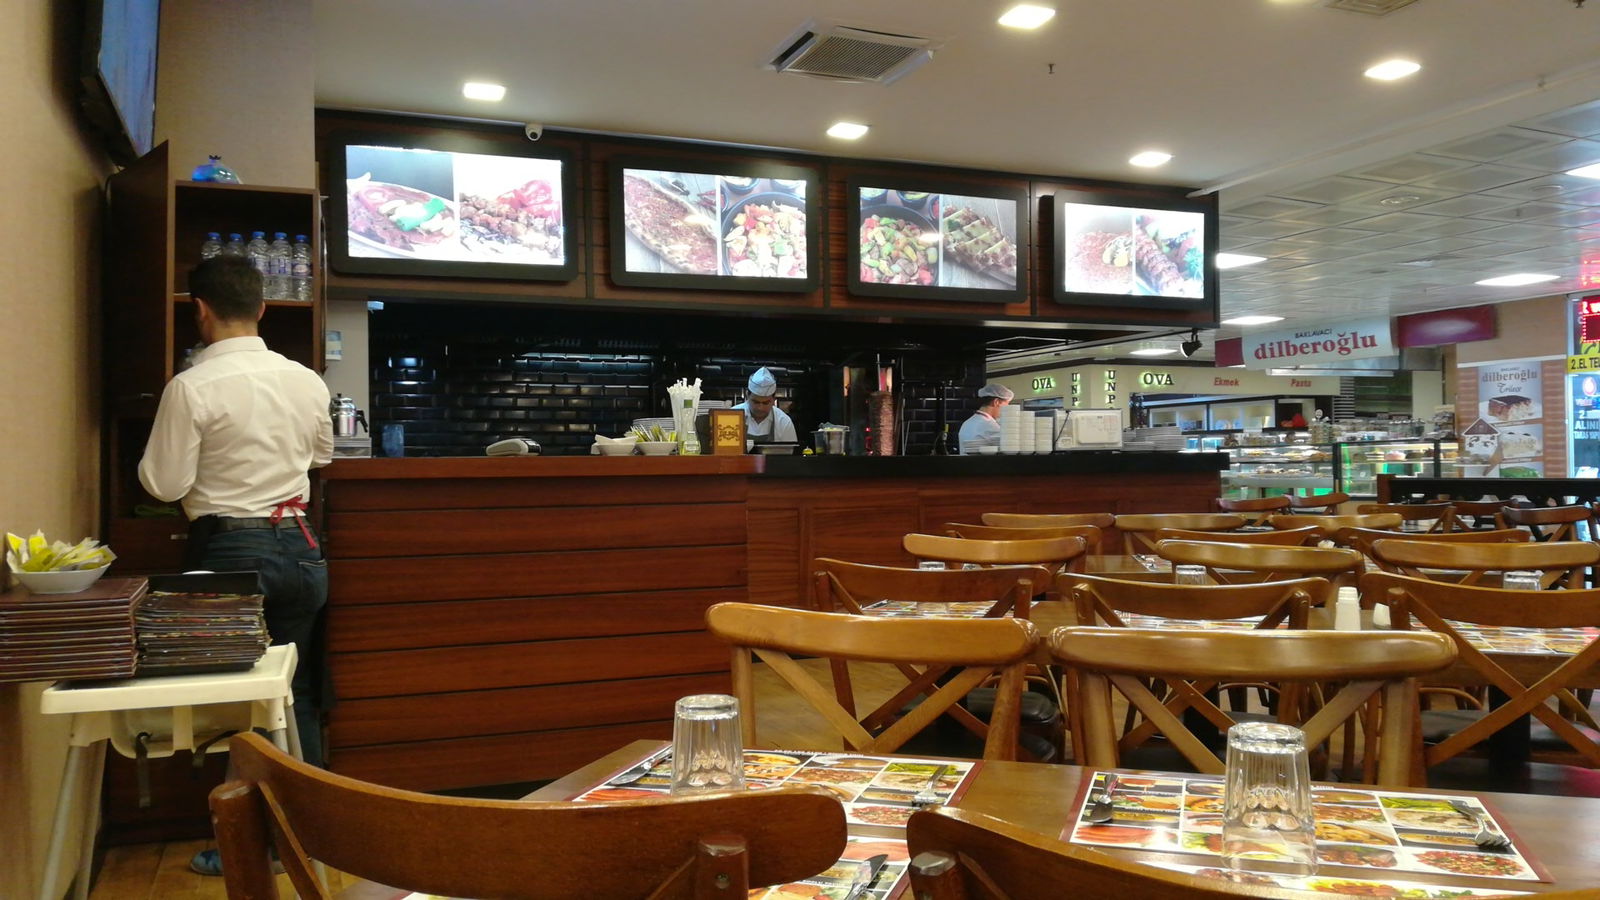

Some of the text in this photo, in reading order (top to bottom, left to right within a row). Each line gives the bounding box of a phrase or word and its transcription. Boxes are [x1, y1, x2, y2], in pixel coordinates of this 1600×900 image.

[1254, 331, 1378, 360] dilberoğlu
[1031, 377, 1053, 391] OVA
[1143, 372, 1174, 386] OVA
[1213, 377, 1240, 387] Ekmek
[1290, 377, 1312, 388] Pasta
[1107, 370, 1117, 408] UNP
